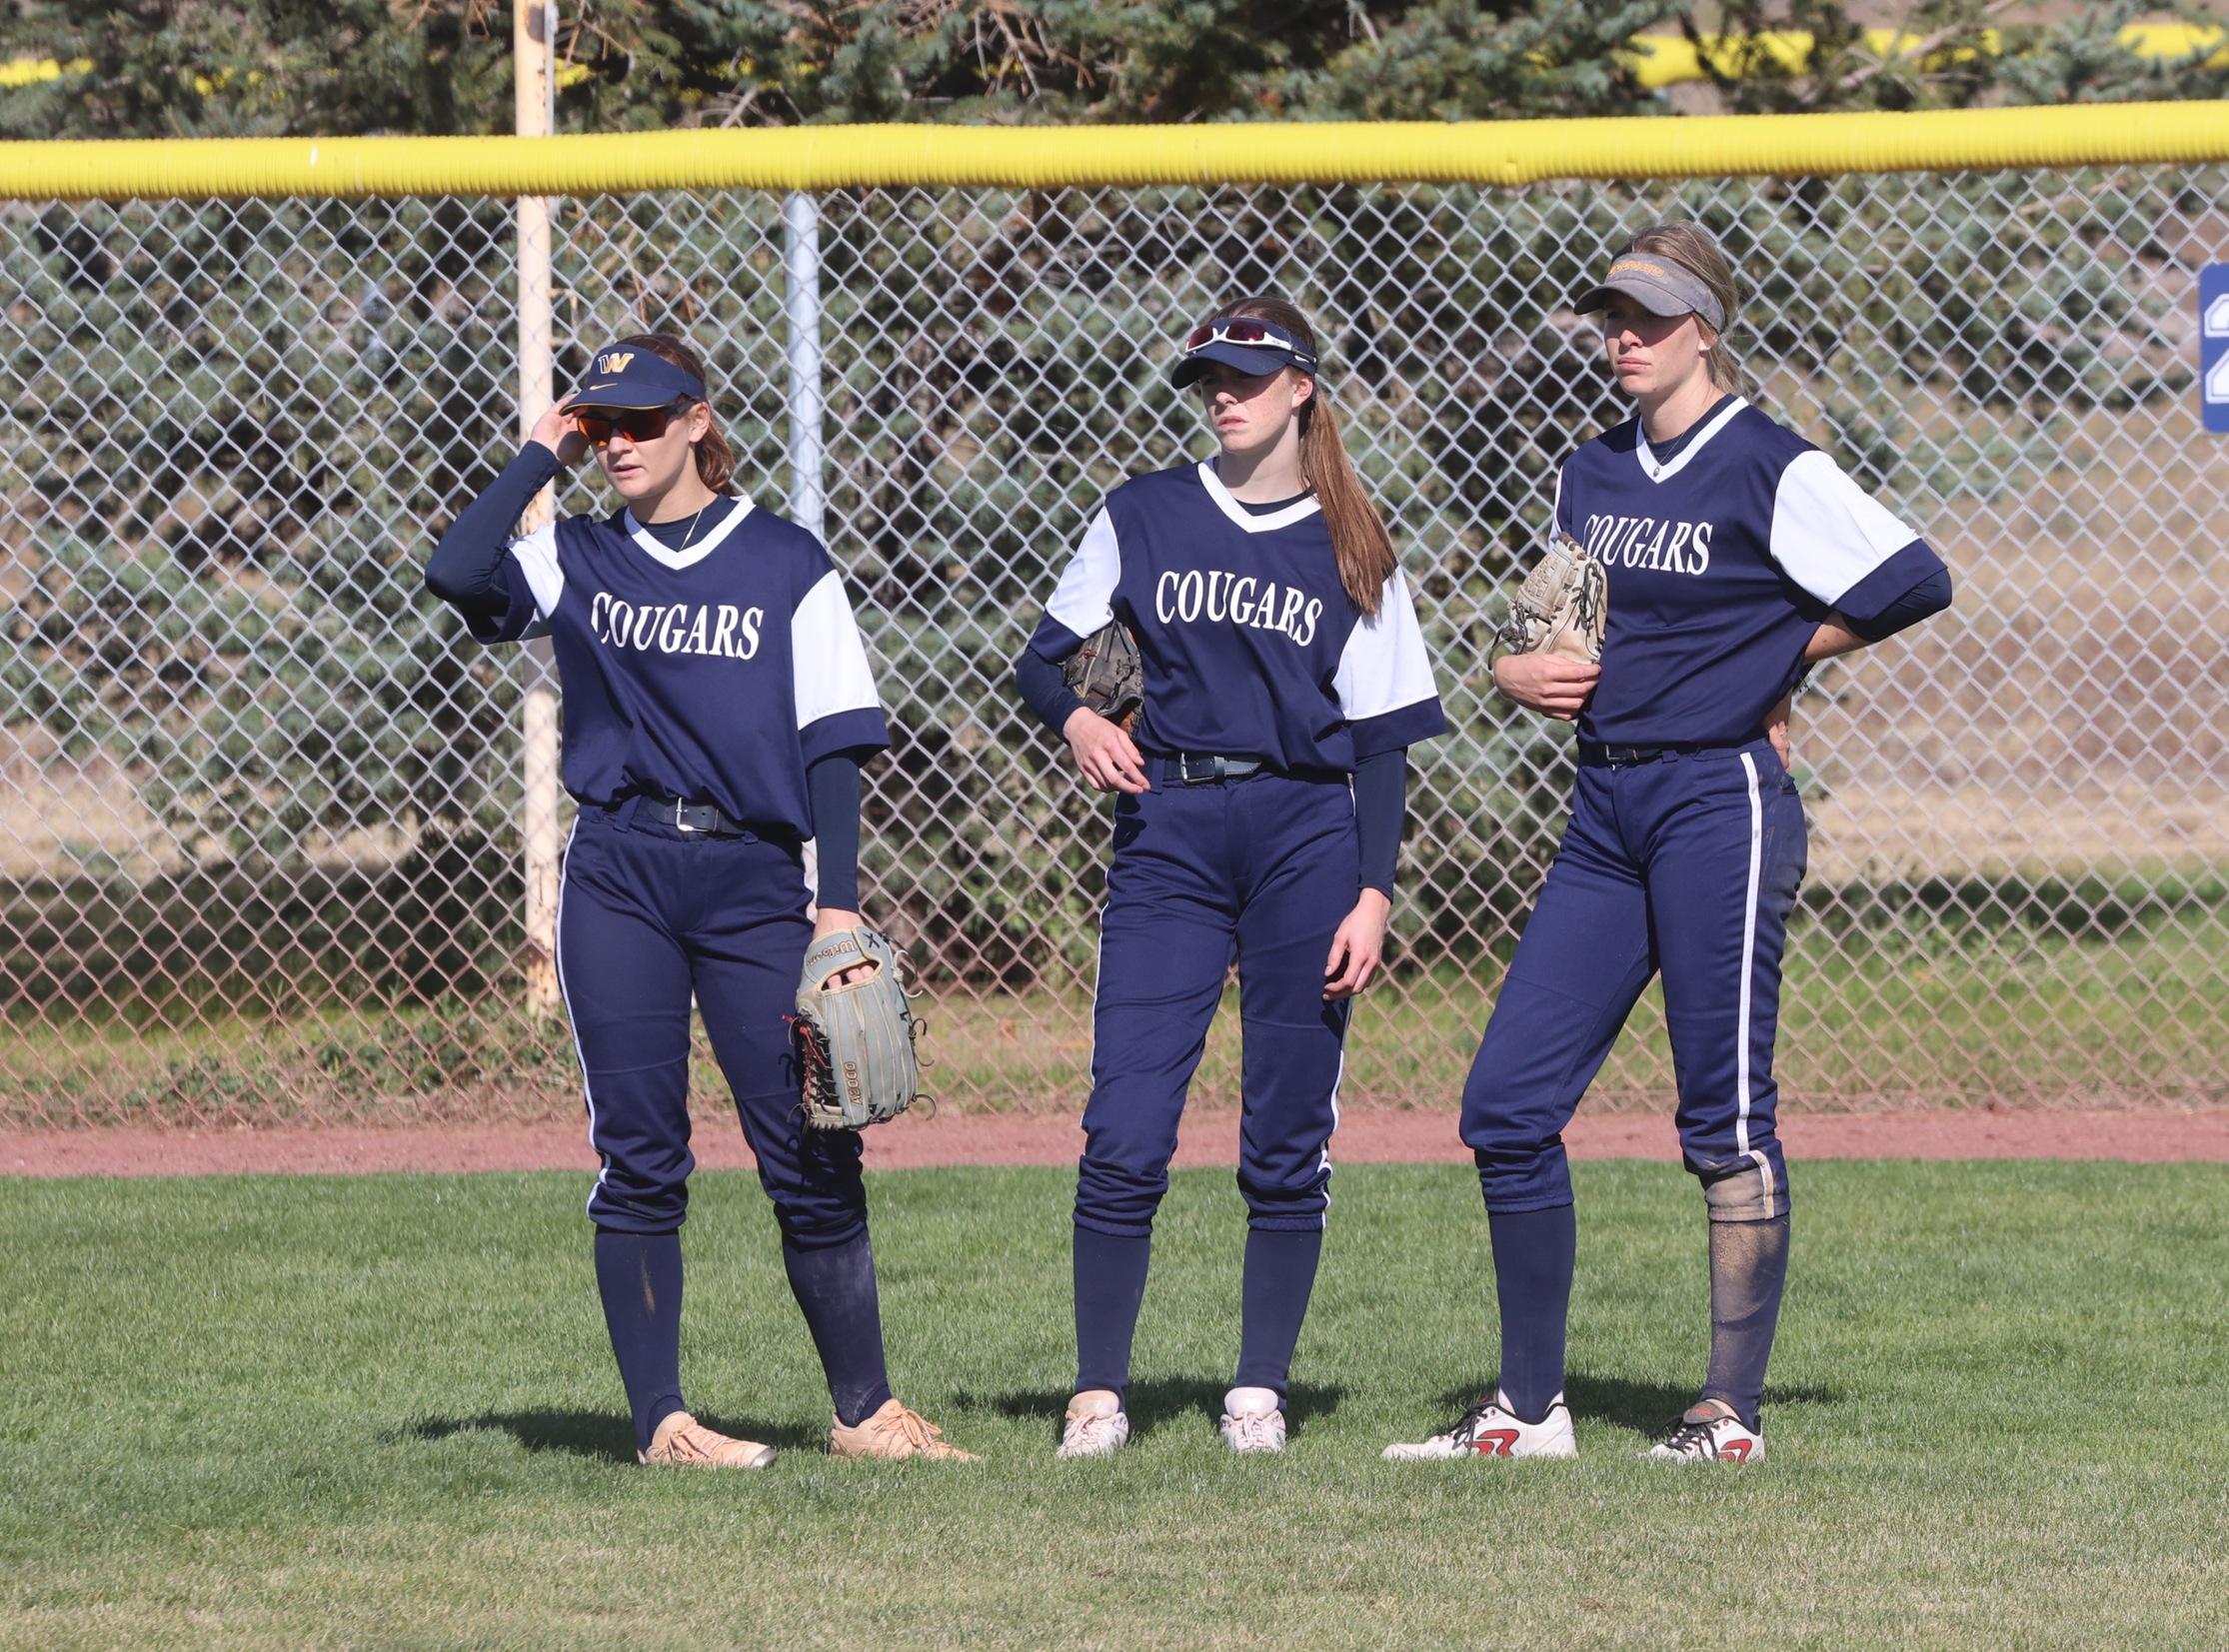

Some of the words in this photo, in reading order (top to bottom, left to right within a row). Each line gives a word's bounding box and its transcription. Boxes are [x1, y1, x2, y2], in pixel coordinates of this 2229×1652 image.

[1581, 514, 1713, 576] COUGARS
[591, 592, 764, 661] COUGARS
[1155, 570, 1323, 647] COUGARS
[807, 939, 858, 966] Wilson
[845, 1060, 863, 1105] A2000
